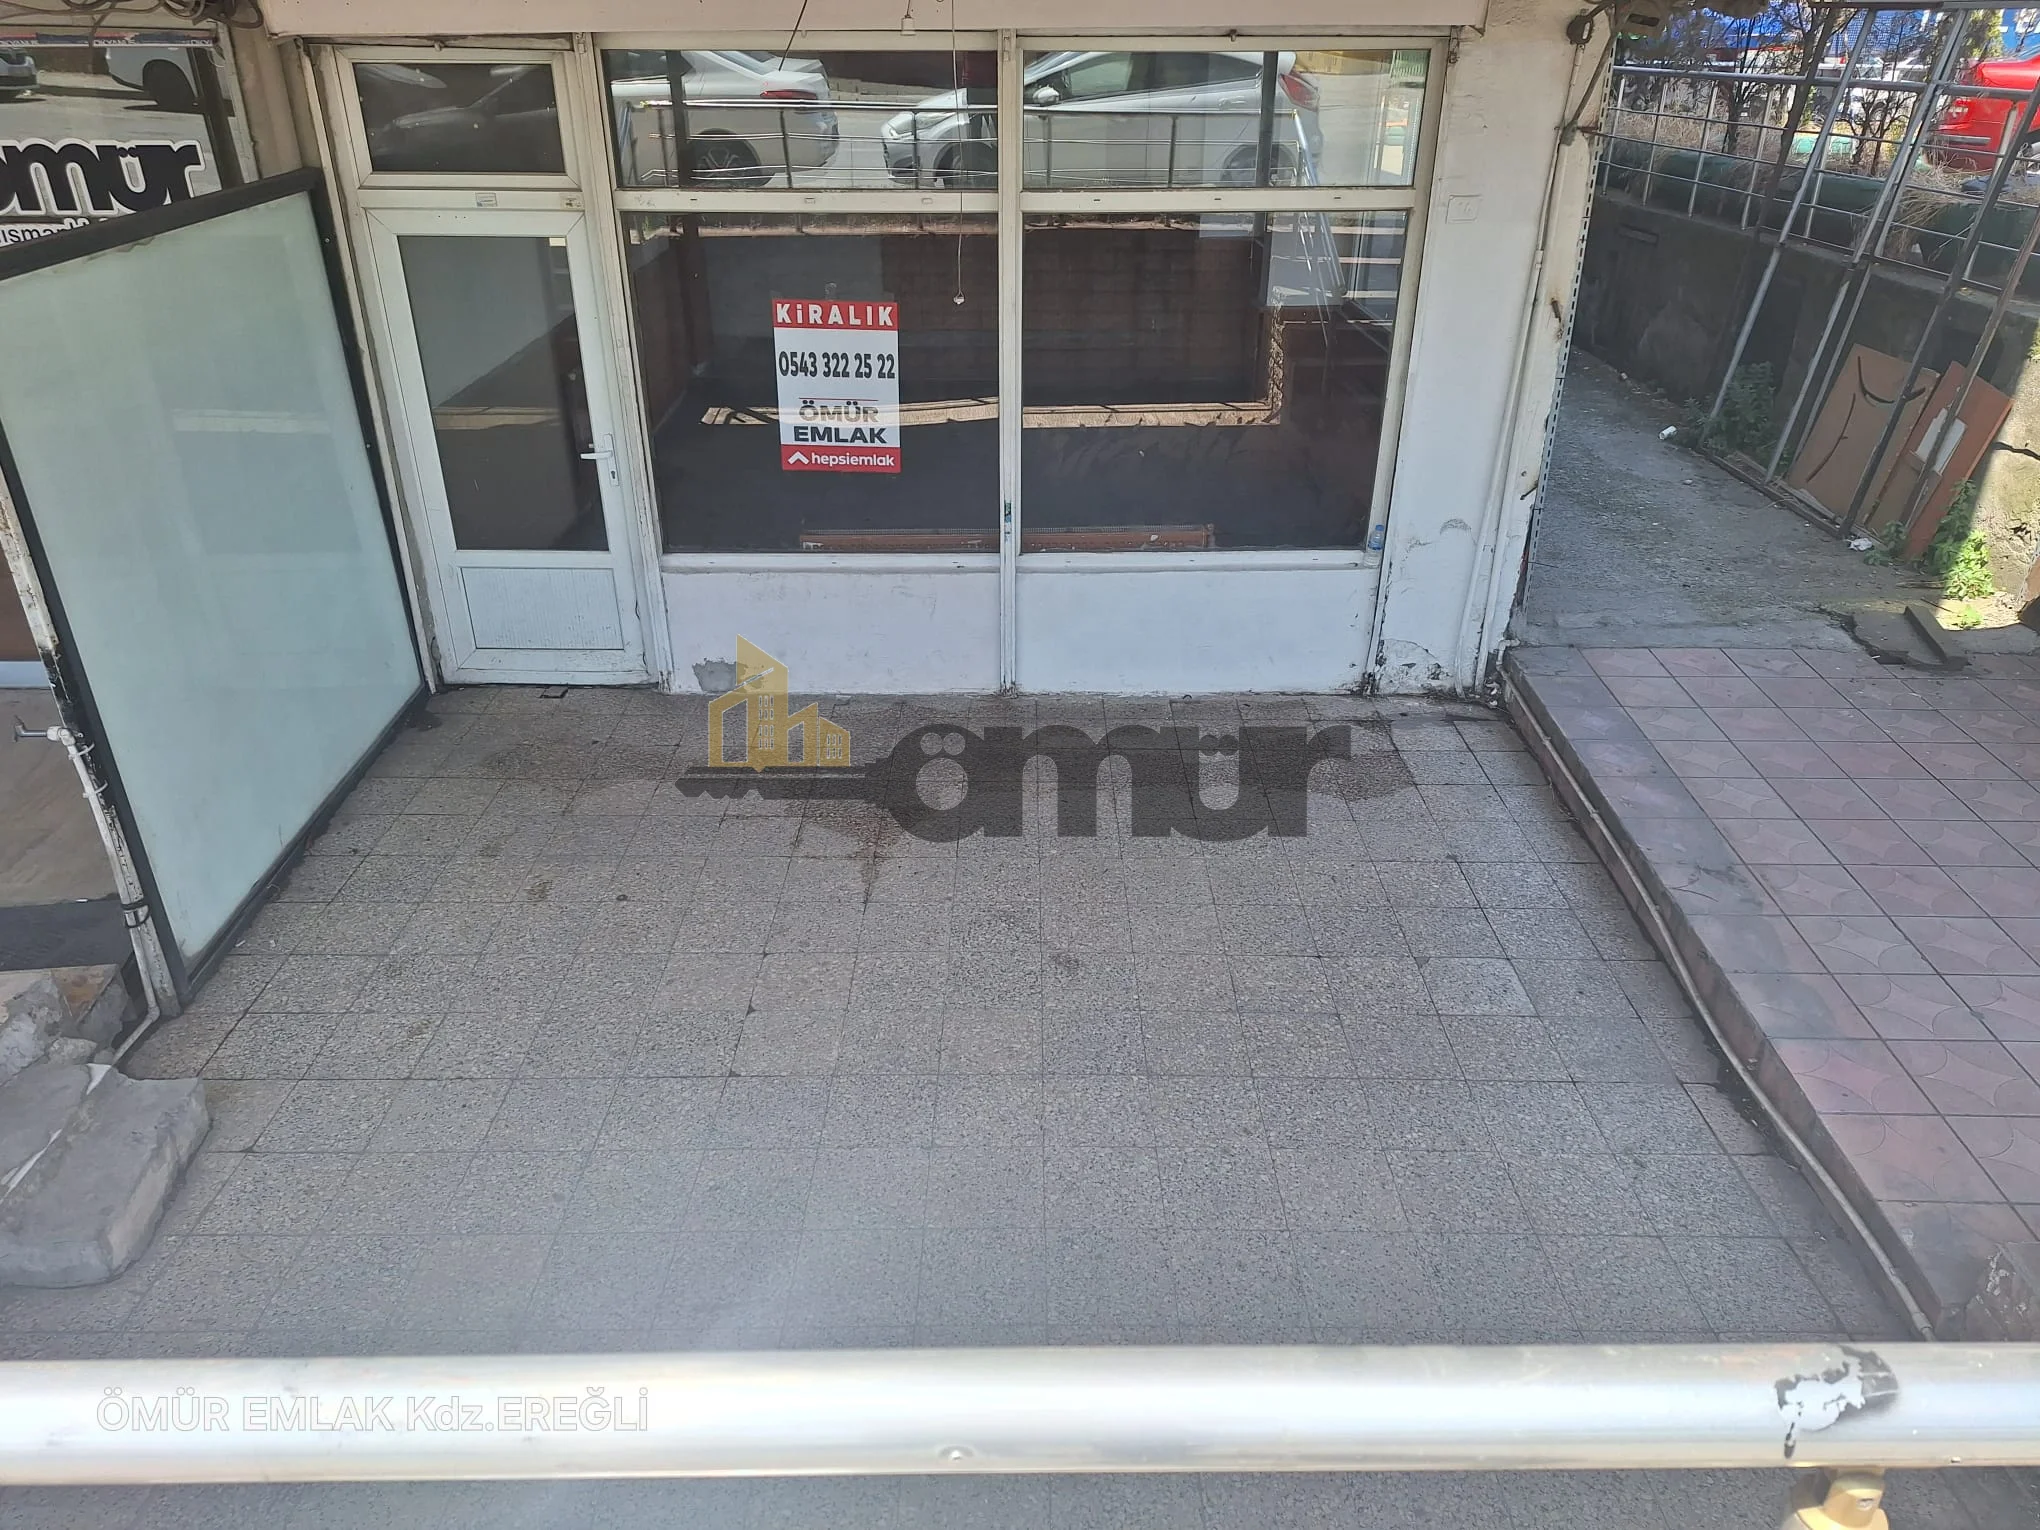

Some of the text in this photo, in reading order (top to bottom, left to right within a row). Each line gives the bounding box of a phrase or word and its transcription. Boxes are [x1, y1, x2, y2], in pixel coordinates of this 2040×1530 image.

[0, 140, 203, 212] mür
[778, 351, 895, 379] 0543 322 25 22
[799, 399, 879, 423] ÖMÜR
[793, 425, 887, 444] EMLAK
[811, 452, 895, 467] hepsiemlak
